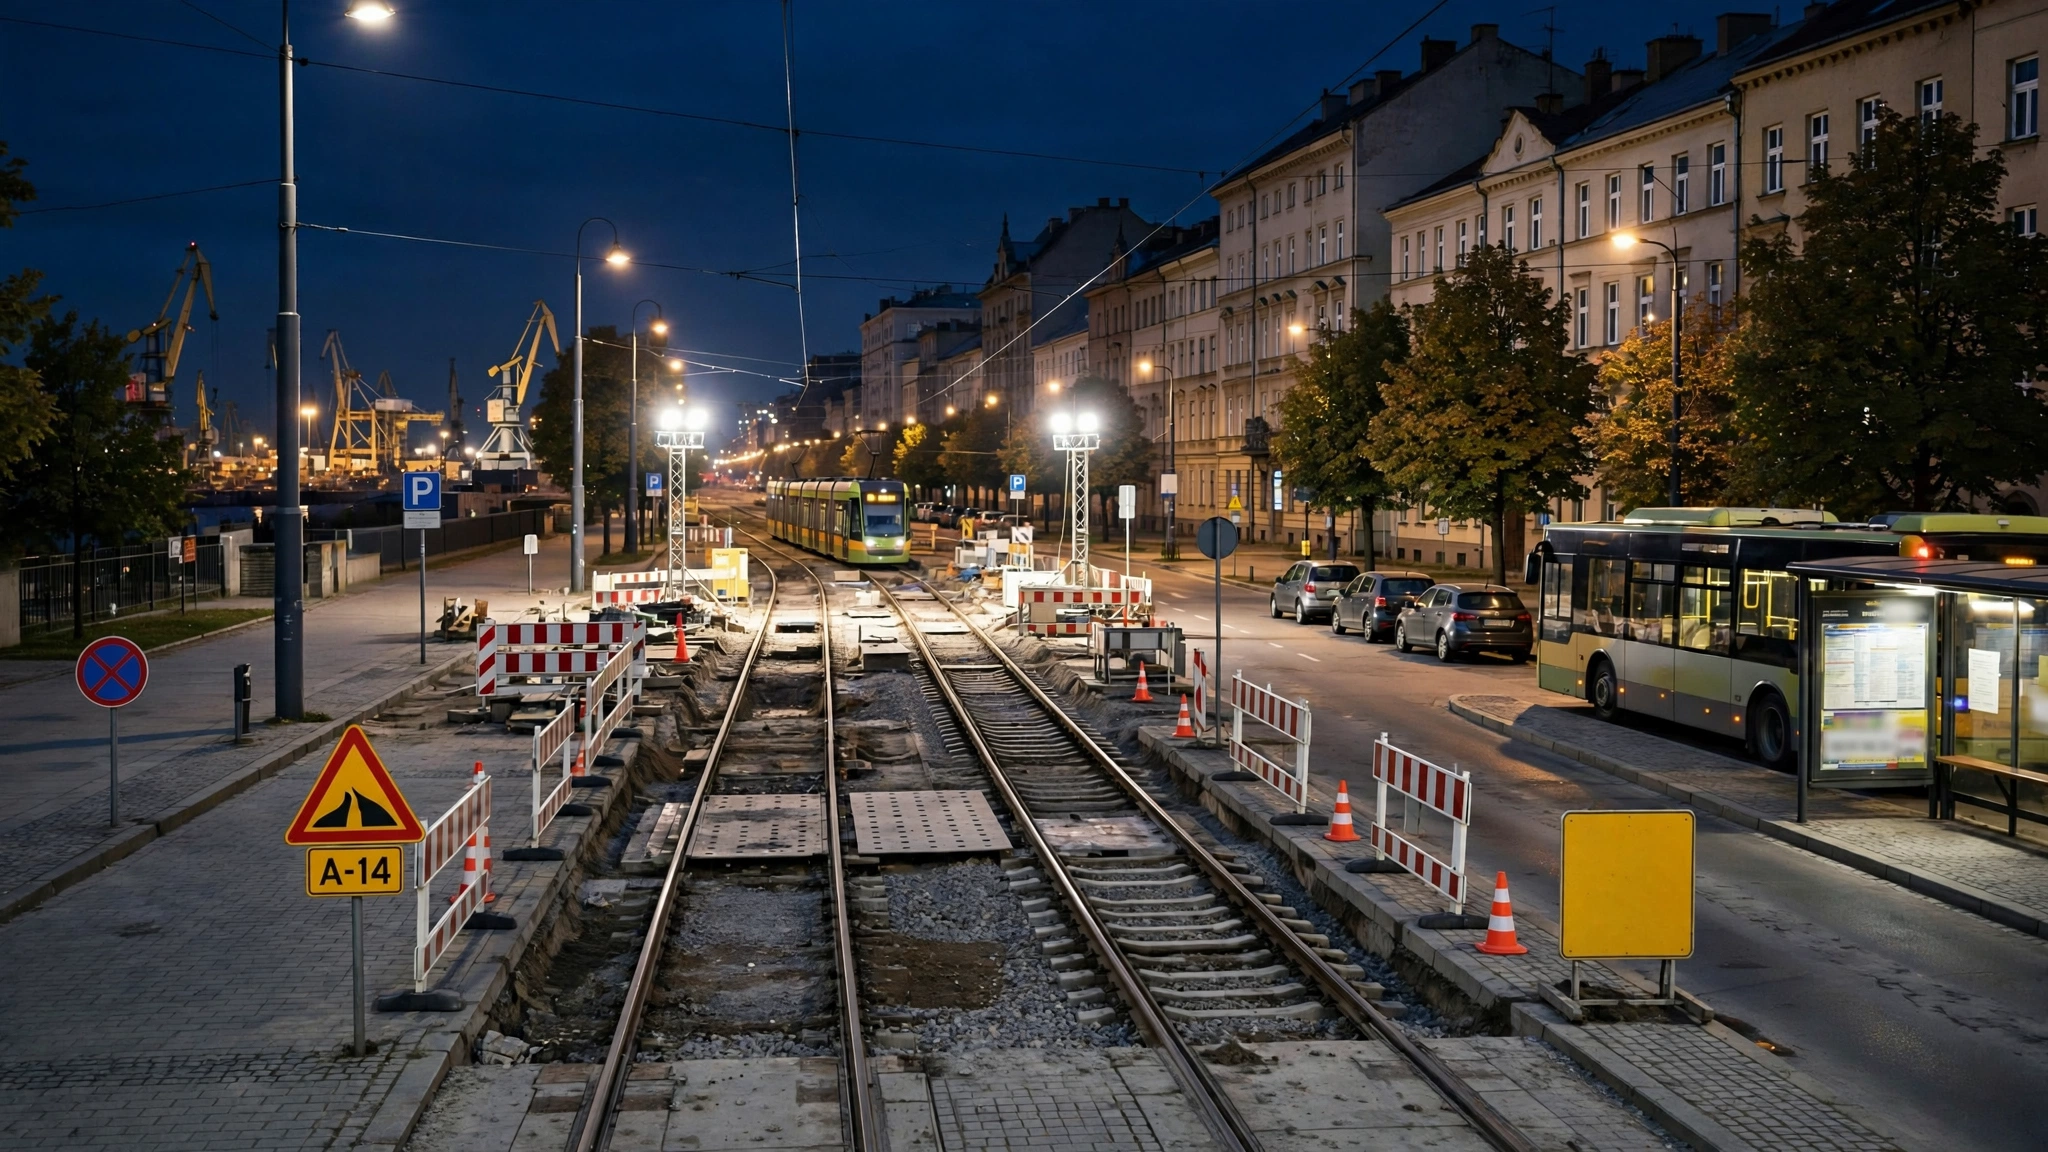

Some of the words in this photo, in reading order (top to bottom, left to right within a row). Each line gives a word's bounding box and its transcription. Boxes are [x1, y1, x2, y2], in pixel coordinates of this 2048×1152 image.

[412, 476, 433, 505] P
[650, 475, 659, 488] P
[1013, 476, 1023, 489] P
[319, 856, 391, 886] A-14
